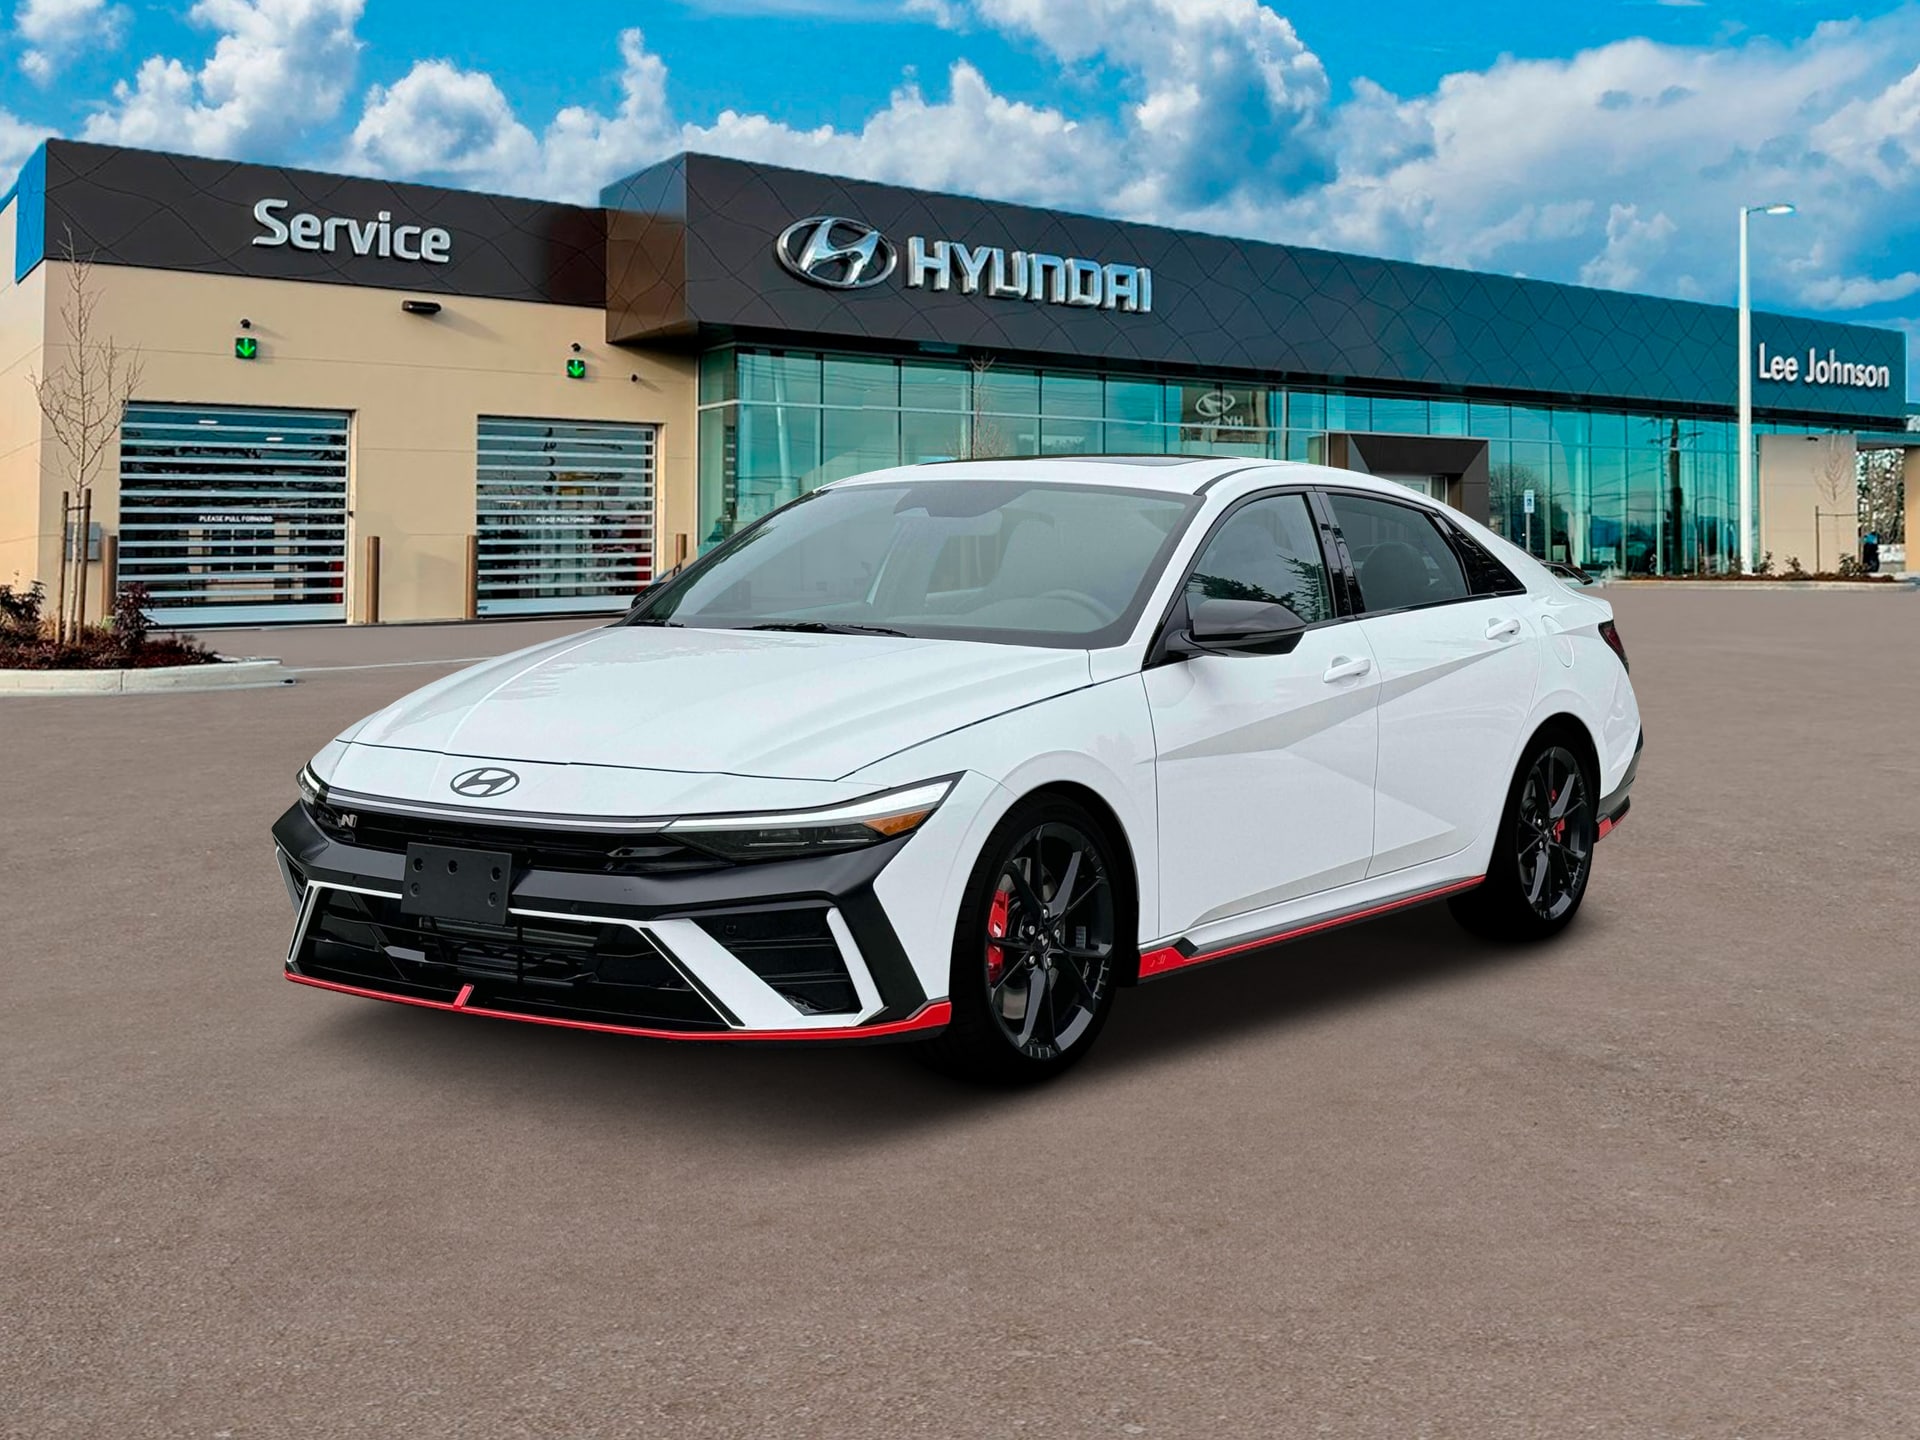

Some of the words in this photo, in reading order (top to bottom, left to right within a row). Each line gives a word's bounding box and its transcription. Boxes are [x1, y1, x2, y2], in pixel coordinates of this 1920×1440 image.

[251, 198, 451, 264] Service
[907, 236, 1153, 313] HYUNDAI
[1758, 342, 1799, 382] Lee
[1803, 347, 1890, 388] Johnson
[198, 514, 224, 523] PLEASE
[224, 514, 241, 523] PULL
